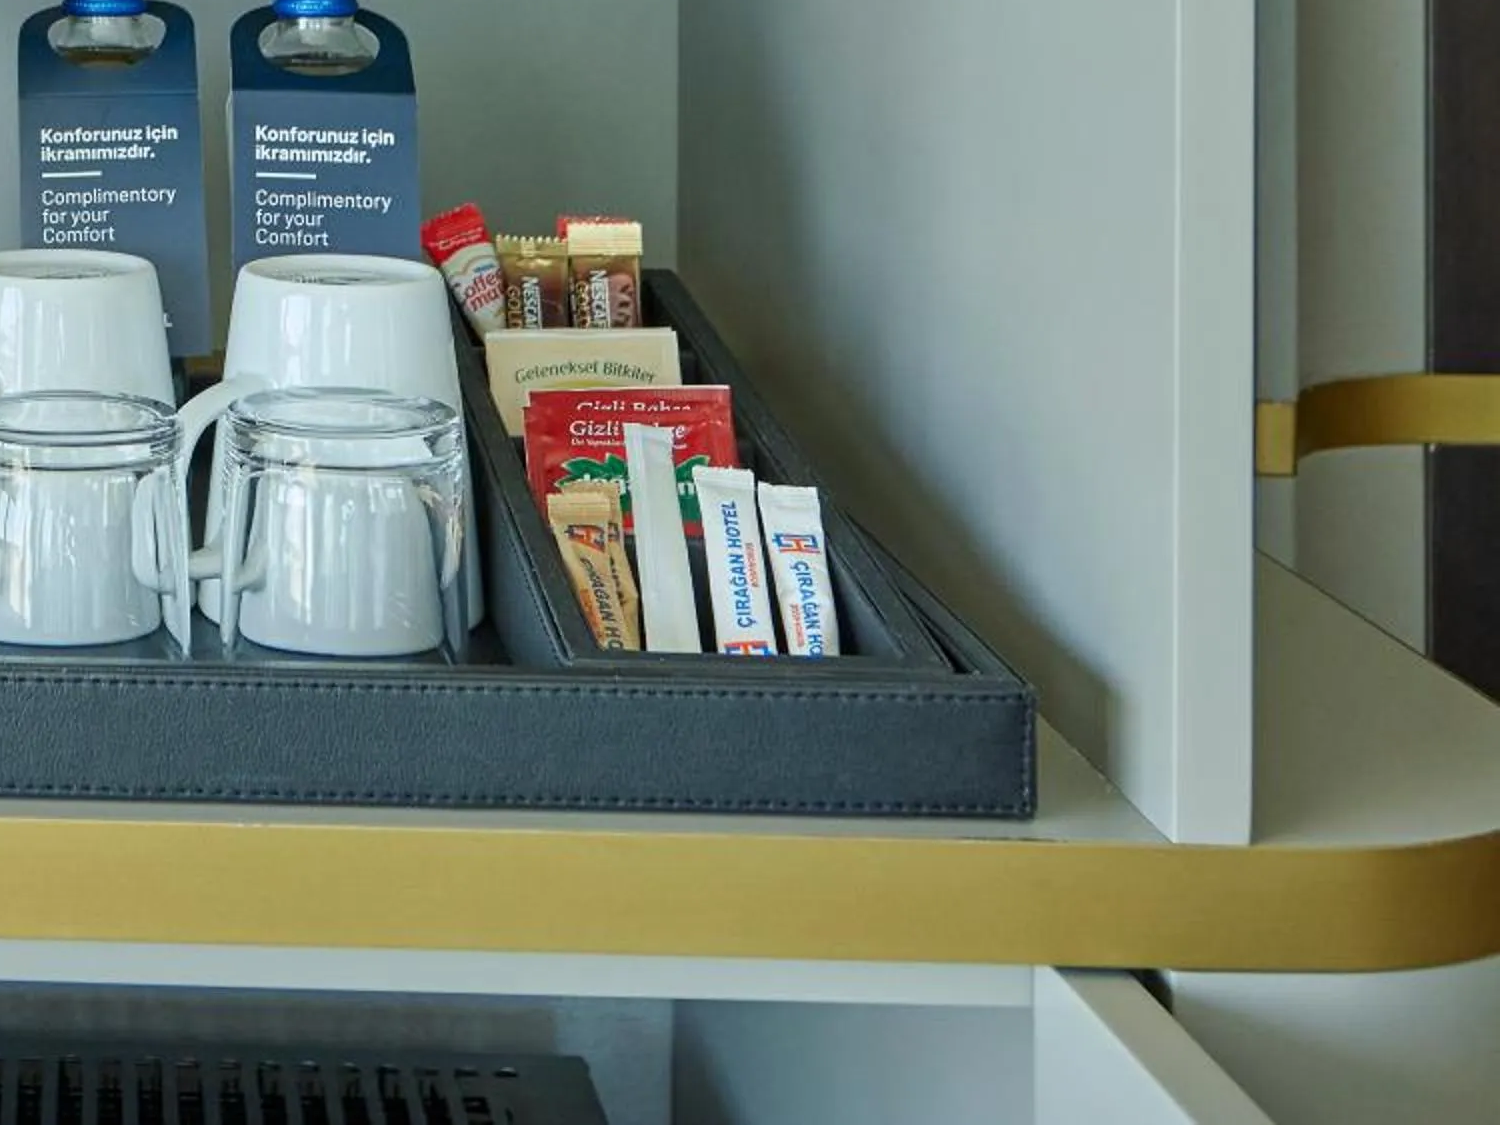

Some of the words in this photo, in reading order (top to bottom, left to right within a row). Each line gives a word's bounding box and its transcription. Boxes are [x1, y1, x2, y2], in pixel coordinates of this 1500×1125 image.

[41, 127, 143, 143] Konforunuz
[146, 125, 178, 143] için
[255, 125, 358, 144] Konforunuz
[362, 128, 395, 147] için
[41, 143, 156, 162] ikramımızdır.
[255, 145, 372, 164] ikramımızdır.
[42, 209, 67, 224] for
[71, 210, 110, 227] your
[255, 209, 280, 225] for
[284, 213, 324, 229] your
[43, 226, 115, 244] Comfort
[255, 228, 329, 246] Comfort
[569, 420, 619, 437] Gizli
[721, 499, 742, 549] HOTEL
[730, 553, 757, 628] ÇIRAĞAN
